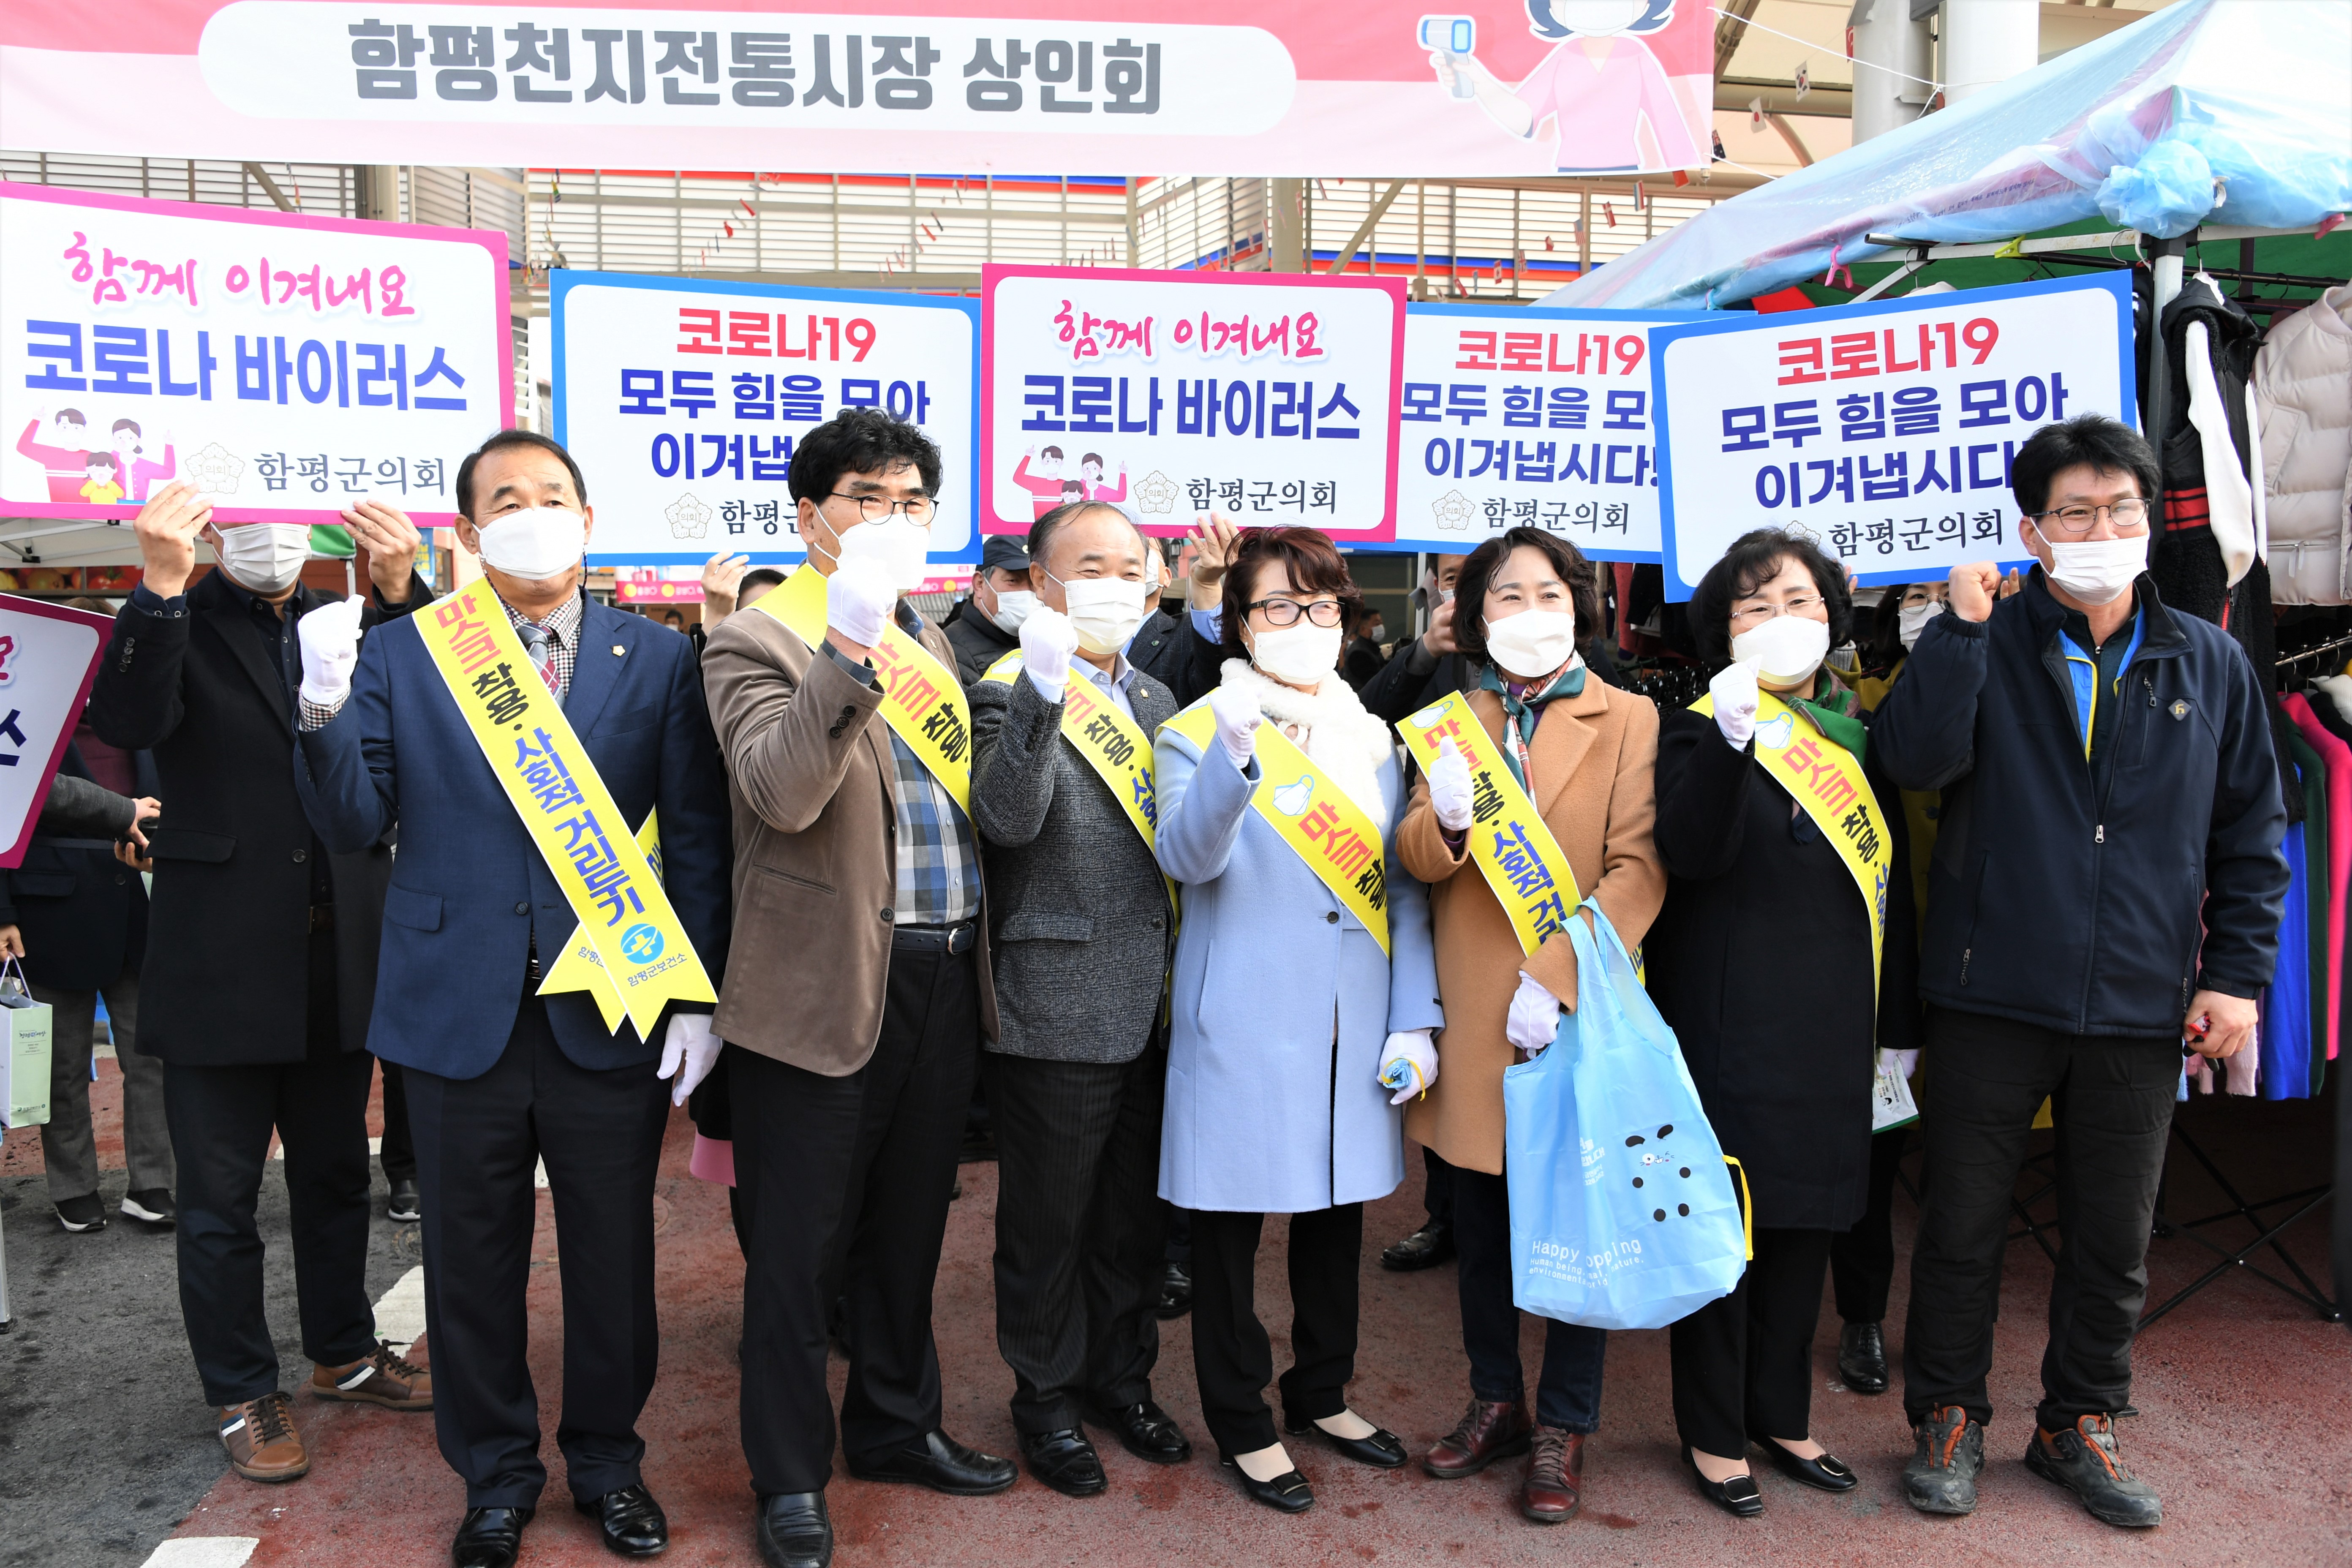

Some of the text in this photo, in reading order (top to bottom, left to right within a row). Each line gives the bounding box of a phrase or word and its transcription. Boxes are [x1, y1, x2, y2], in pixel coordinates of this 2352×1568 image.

[349, 19, 1160, 112] 함평천지전통시장 상인회
[64, 231, 414, 316] 함께 이겨내요
[678, 308, 876, 362] 코로나19
[1054, 300, 1323, 359] 함께 이겨내요
[1456, 331, 1644, 375] 코로나19
[1778, 318, 1998, 385] 코로나19
[26, 320, 466, 410] 코로나 바이러스
[620, 369, 716, 418] 모두
[732, 373, 824, 421] 힘을
[1022, 375, 1360, 439] 코로나 바이러스
[1401, 383, 1655, 430] 모두 힘을 모
[1722, 372, 2068, 452] 모두 힘을 모아
[255, 453, 444, 495] 함평군의회
[1149, 489, 1164, 498] 의회
[1186, 478, 1335, 514] 함평군의회
[681, 513, 697, 522] 의회
[1482, 498, 1628, 535] 함평군의회
[1828, 509, 2003, 557] 함평군의회
[921, 702, 968, 763] 착용
[1083, 713, 1134, 767] 착용
[435, 593, 645, 927] 마스크 착용 사회적 거리두기
[1783, 739, 1857, 816] 마스크
[1841, 803, 1880, 863] 착용
[1300, 803, 1372, 878] 마스크
[1493, 821, 1554, 899] 사회적
[627, 953, 687, 987] 함평군보건소
[1530, 1258, 1553, 1267] Human
[1532, 1240, 1579, 1263] Happy
